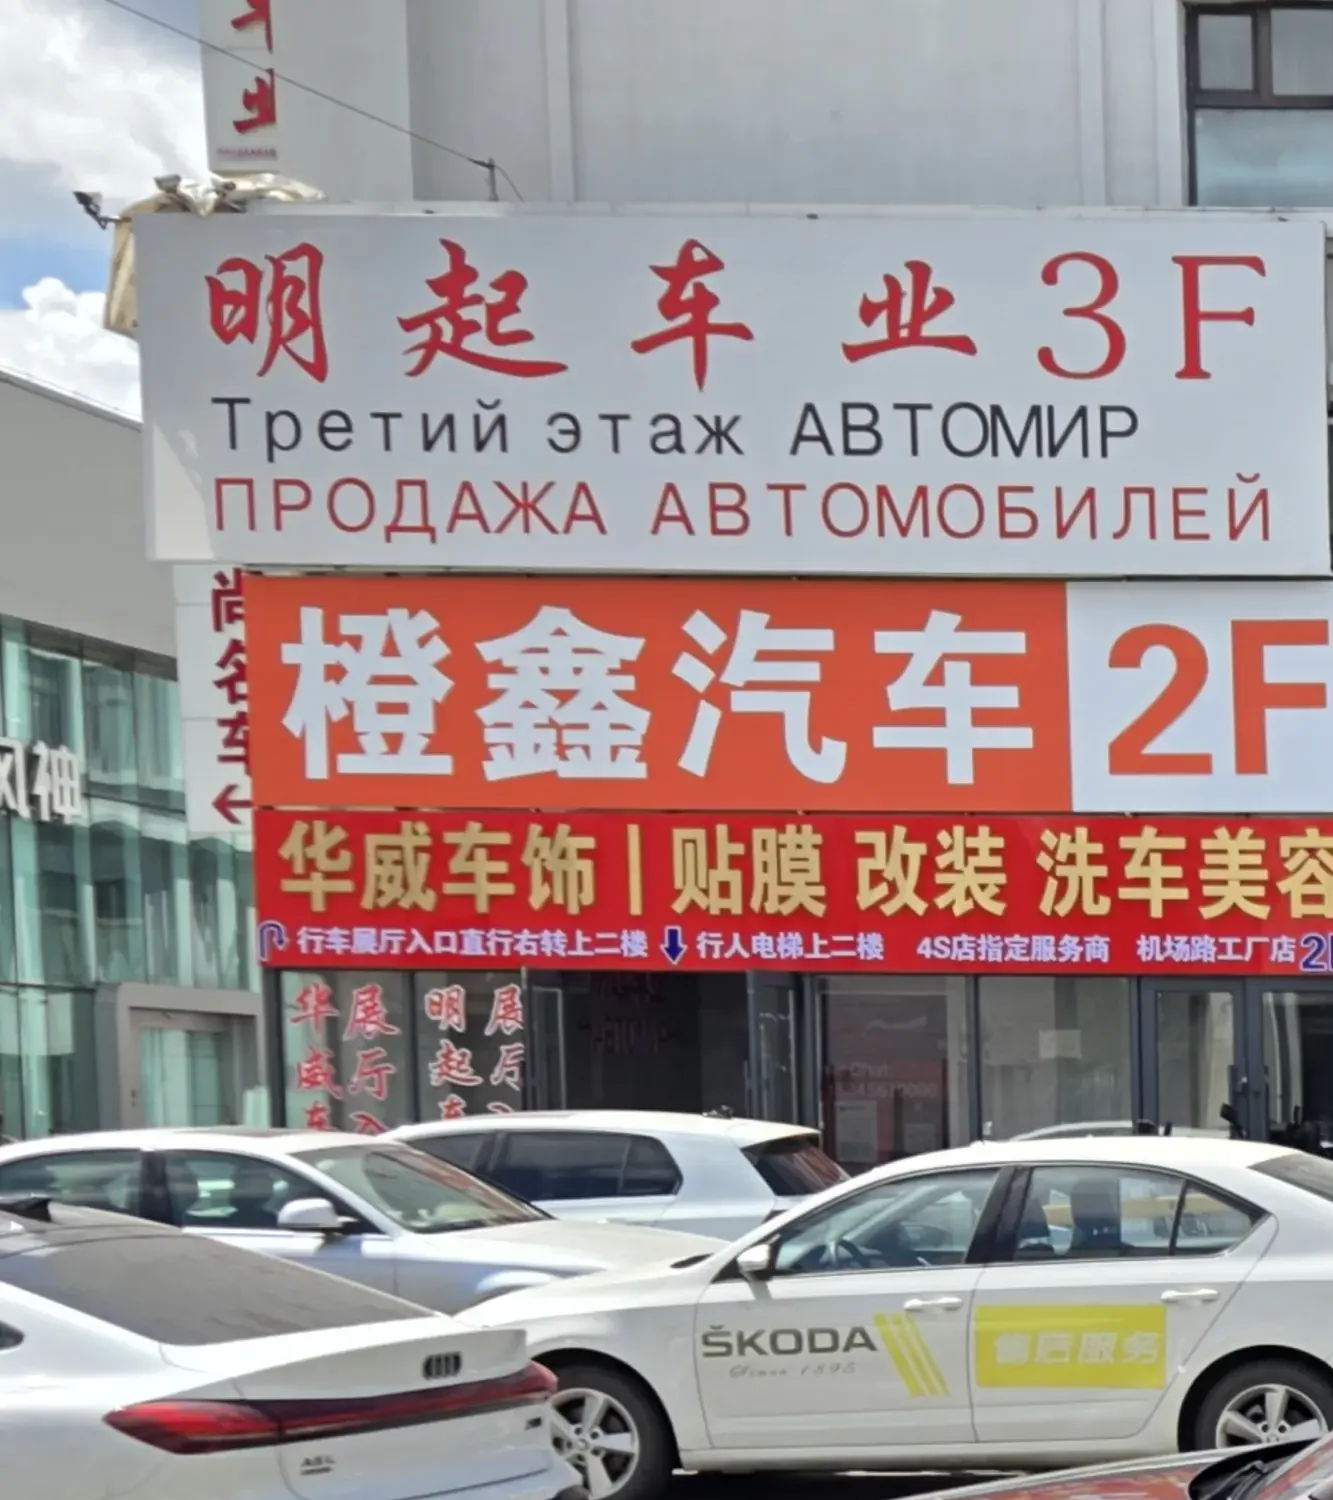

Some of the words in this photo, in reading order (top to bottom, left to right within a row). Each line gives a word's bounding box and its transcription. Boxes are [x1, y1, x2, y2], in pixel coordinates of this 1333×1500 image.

[211, 397, 508, 463] Третий
[546, 411, 745, 456] этаж
[790, 402, 1139, 459] АВТОМИР
[214, 477, 607, 543] ПРОДАЖА
[650, 472, 1272, 541] АВТОМОБИЛЕЙ
[281, 604, 1034, 786] 橙鑫汽车
[1106, 617, 1331, 778] 2F
[278, 819, 597, 916] 华威车饰
[671, 823, 828, 917] 贴膜
[855, 825, 1008, 917] 改装
[297, 926, 649, 957] 行车展厅入口直行右转上二楼
[697, 932, 885, 961] 行人电梯上二楼
[916, 934, 1111, 962] 4S店指定服务商
[701, 1324, 879, 1358] ŠKODA
